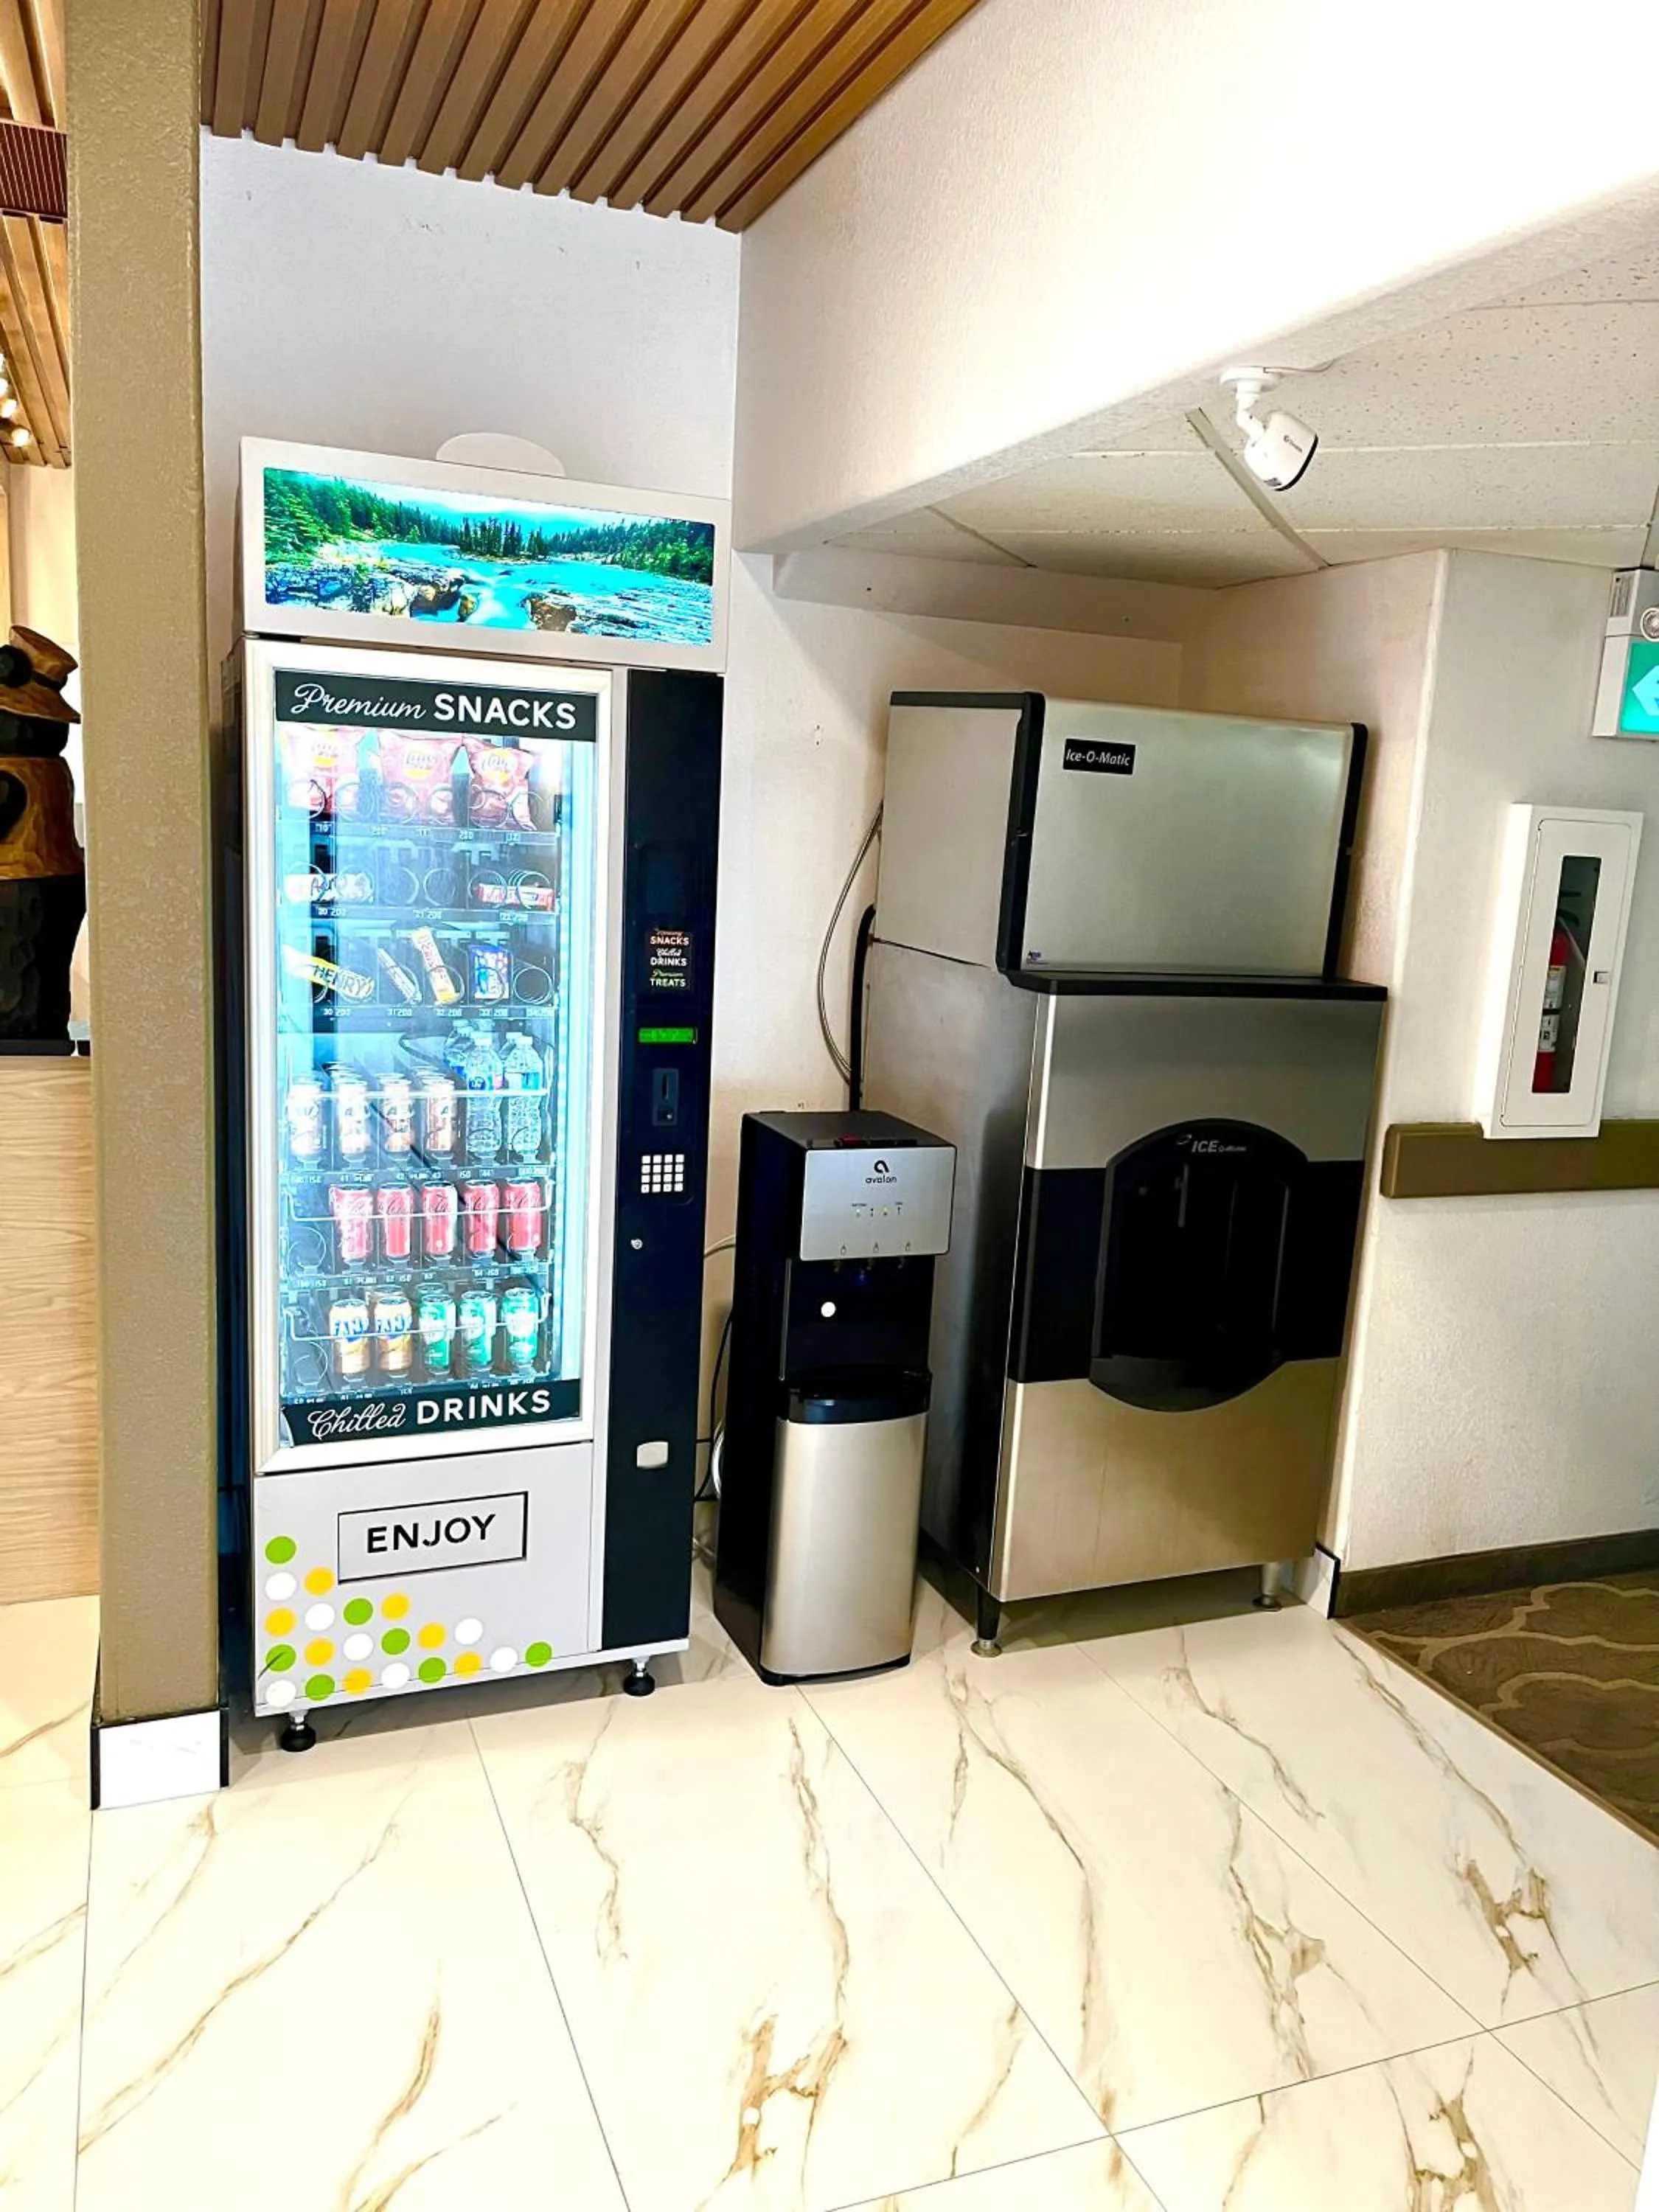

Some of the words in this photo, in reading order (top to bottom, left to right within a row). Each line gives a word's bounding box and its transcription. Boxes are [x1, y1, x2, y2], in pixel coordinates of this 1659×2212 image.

[291, 683, 427, 719] Premium
[434, 692, 577, 729] SNACKS
[1066, 748, 1130, 766] Ice-O-Matic
[650, 936, 689, 945] SNACKS
[650, 957, 687, 967] DRINKS
[650, 978, 686, 987] TREATS
[1192, 1141, 1220, 1152] ICE
[865, 1175, 897, 1183] avalon
[307, 1402, 406, 1440] Chilled
[417, 1389, 551, 1425] DRINKS
[367, 1514, 496, 1554] ENJOY
